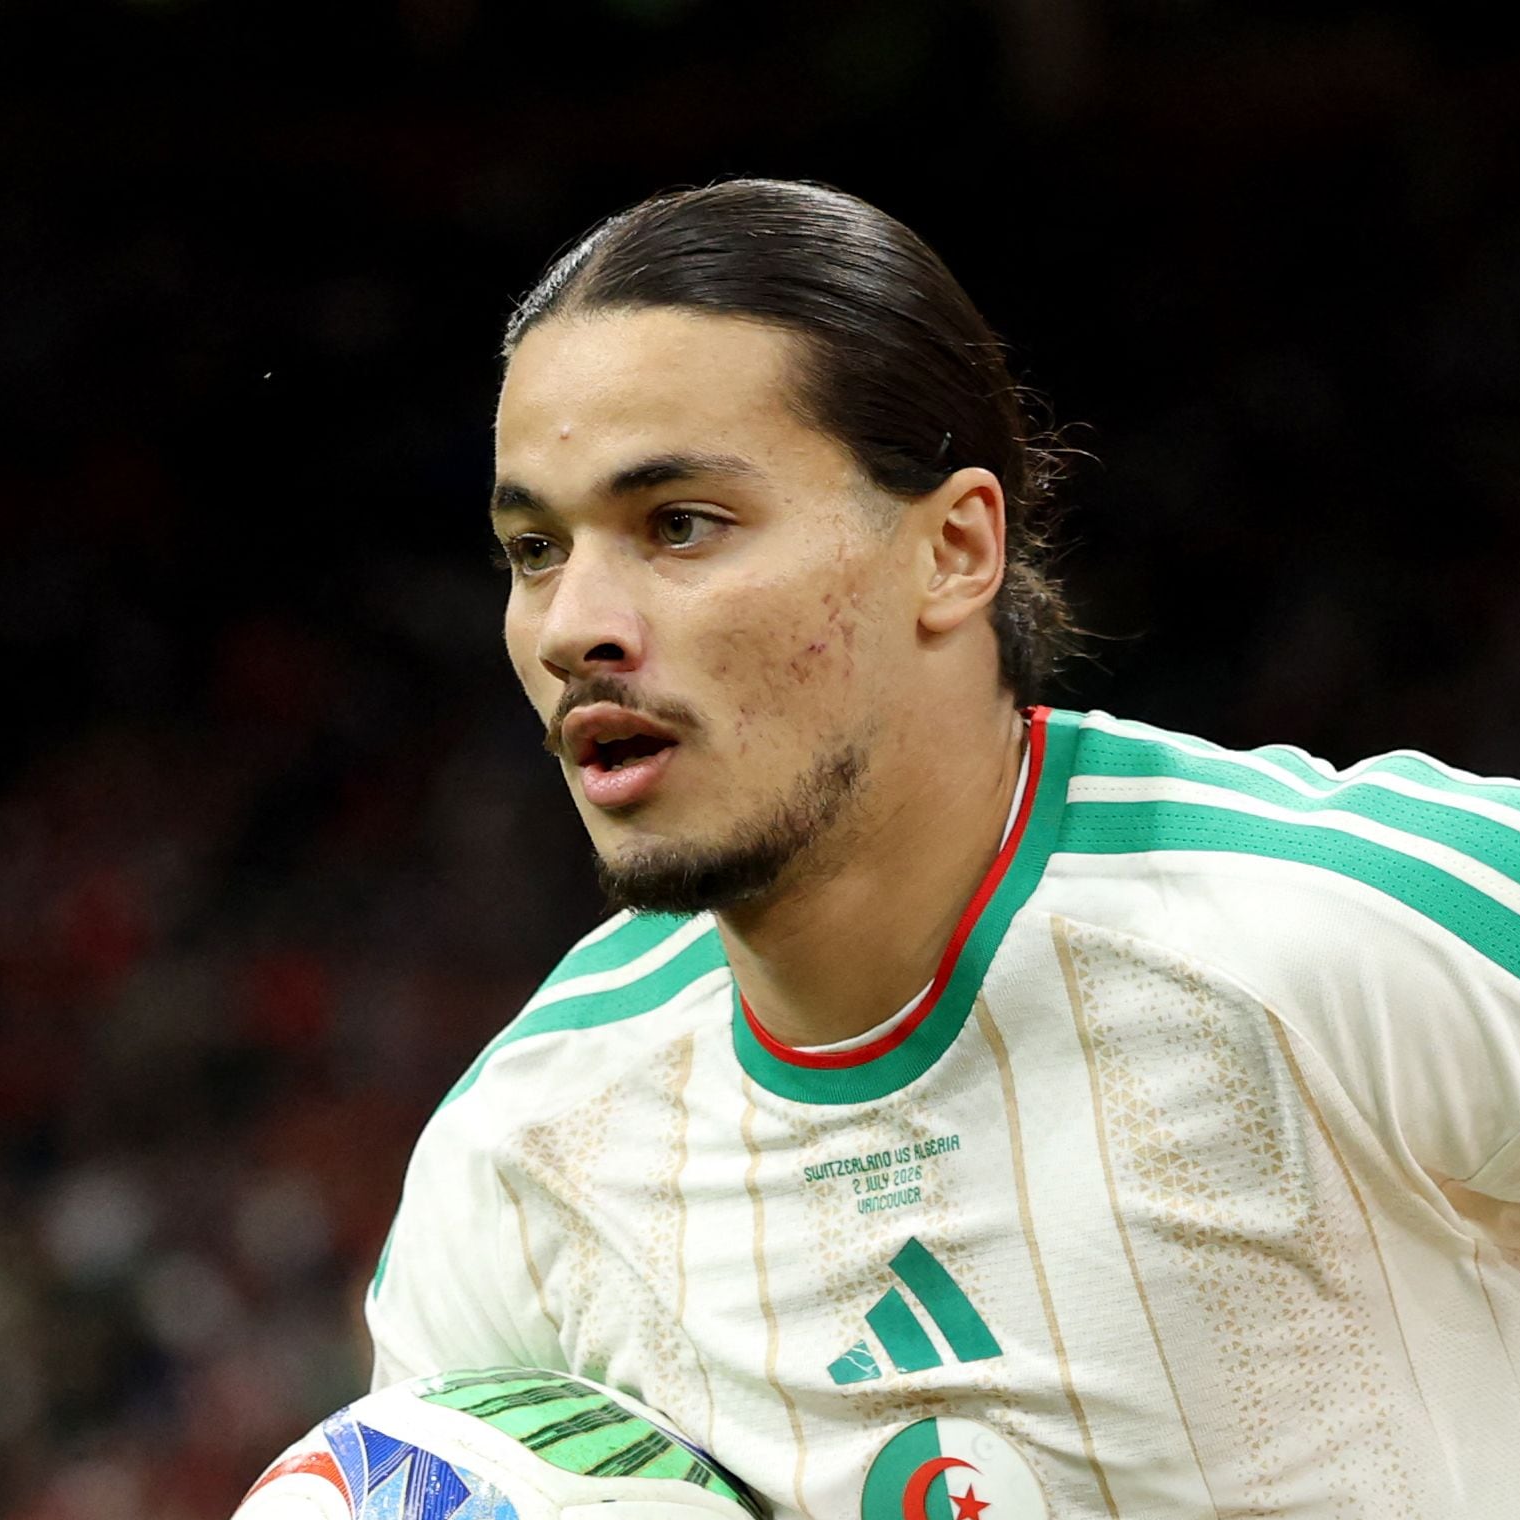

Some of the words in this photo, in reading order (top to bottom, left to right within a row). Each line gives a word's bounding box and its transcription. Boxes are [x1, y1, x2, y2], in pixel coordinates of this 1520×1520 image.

[804, 1151, 891, 1182] SWITZERLAND
[914, 1134, 960, 1159] ALGERIA
[853, 1179, 861, 1194] 2
[866, 1173, 889, 1191] JULY
[894, 1165, 922, 1186] 2026
[857, 1187, 921, 1214] VANCOUVER
